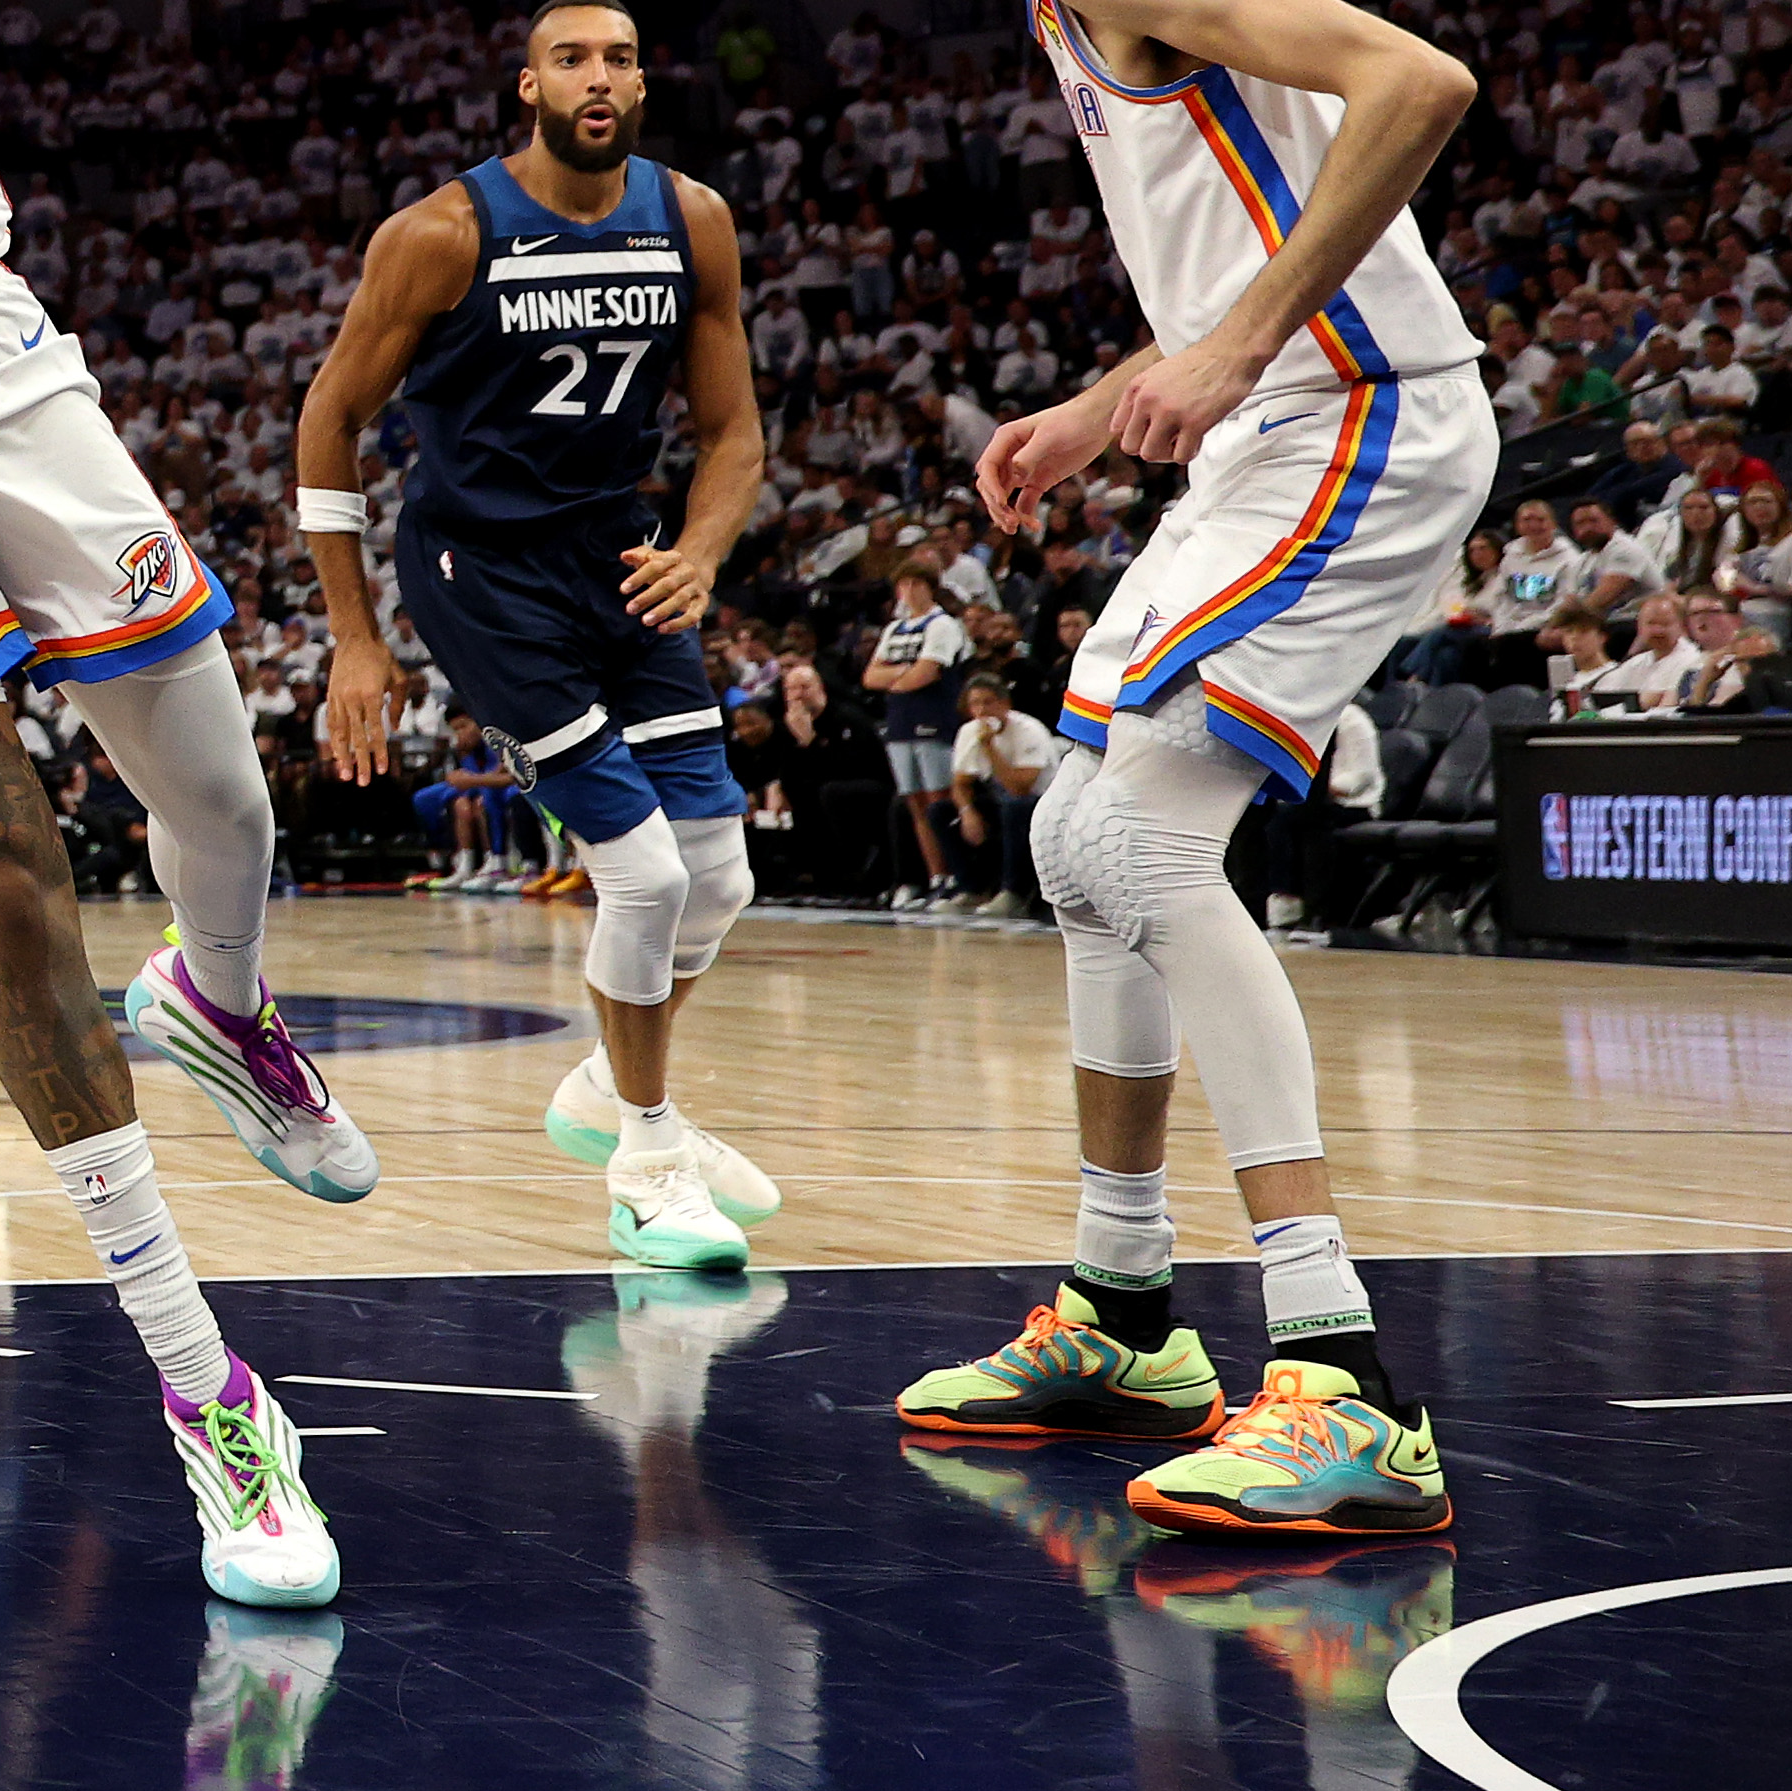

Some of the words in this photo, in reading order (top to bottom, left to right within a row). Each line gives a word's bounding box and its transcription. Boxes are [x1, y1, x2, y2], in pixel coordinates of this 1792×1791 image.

[498, 285, 677, 335] MINNESOTA
[529, 339, 653, 416] 27
[132, 538, 167, 606] OKC
[1570, 794, 1708, 881] WESTERN
